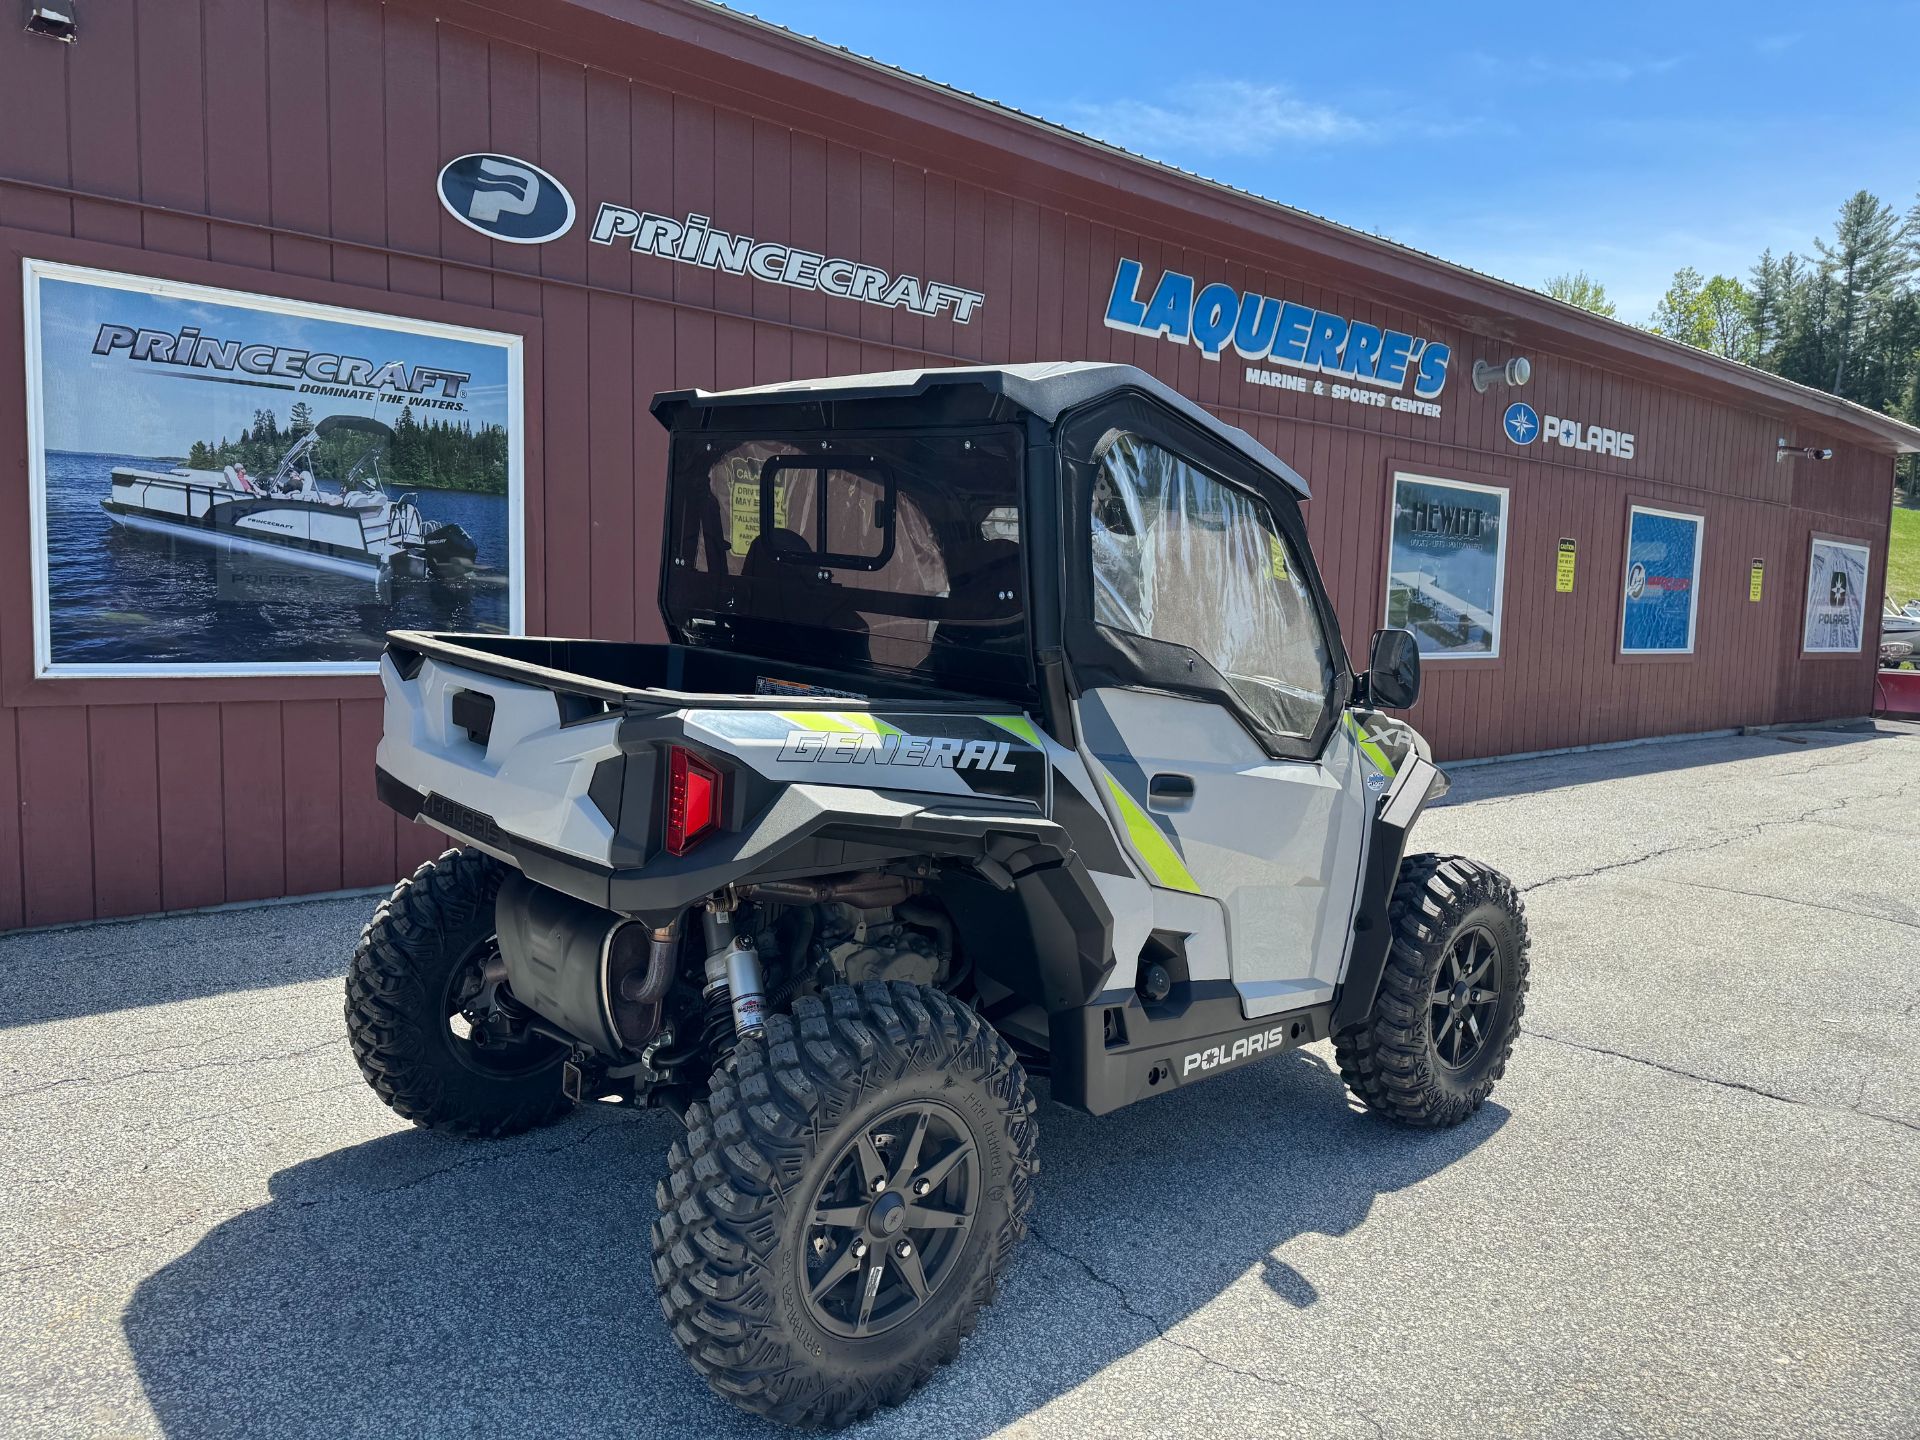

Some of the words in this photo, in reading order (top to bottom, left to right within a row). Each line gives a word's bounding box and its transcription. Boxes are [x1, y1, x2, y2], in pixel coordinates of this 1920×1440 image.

[1104, 257, 1451, 399] LAQUERRE'S
[299, 384, 376, 401] DOMINATE
[379, 392, 406, 404] THE
[1246, 367, 1307, 393] MARINE
[1312, 380, 1325, 396] &
[1331, 384, 1386, 408] SPORTS
[1391, 396, 1442, 418] CENTER
[1542, 415, 1635, 460] POLARIS
[1411, 502, 1483, 537] HEWITT
[1818, 613, 1850, 625] POLARIS
[776, 729, 1017, 772] GENERAL
[1183, 1026, 1283, 1077] POLARIS
